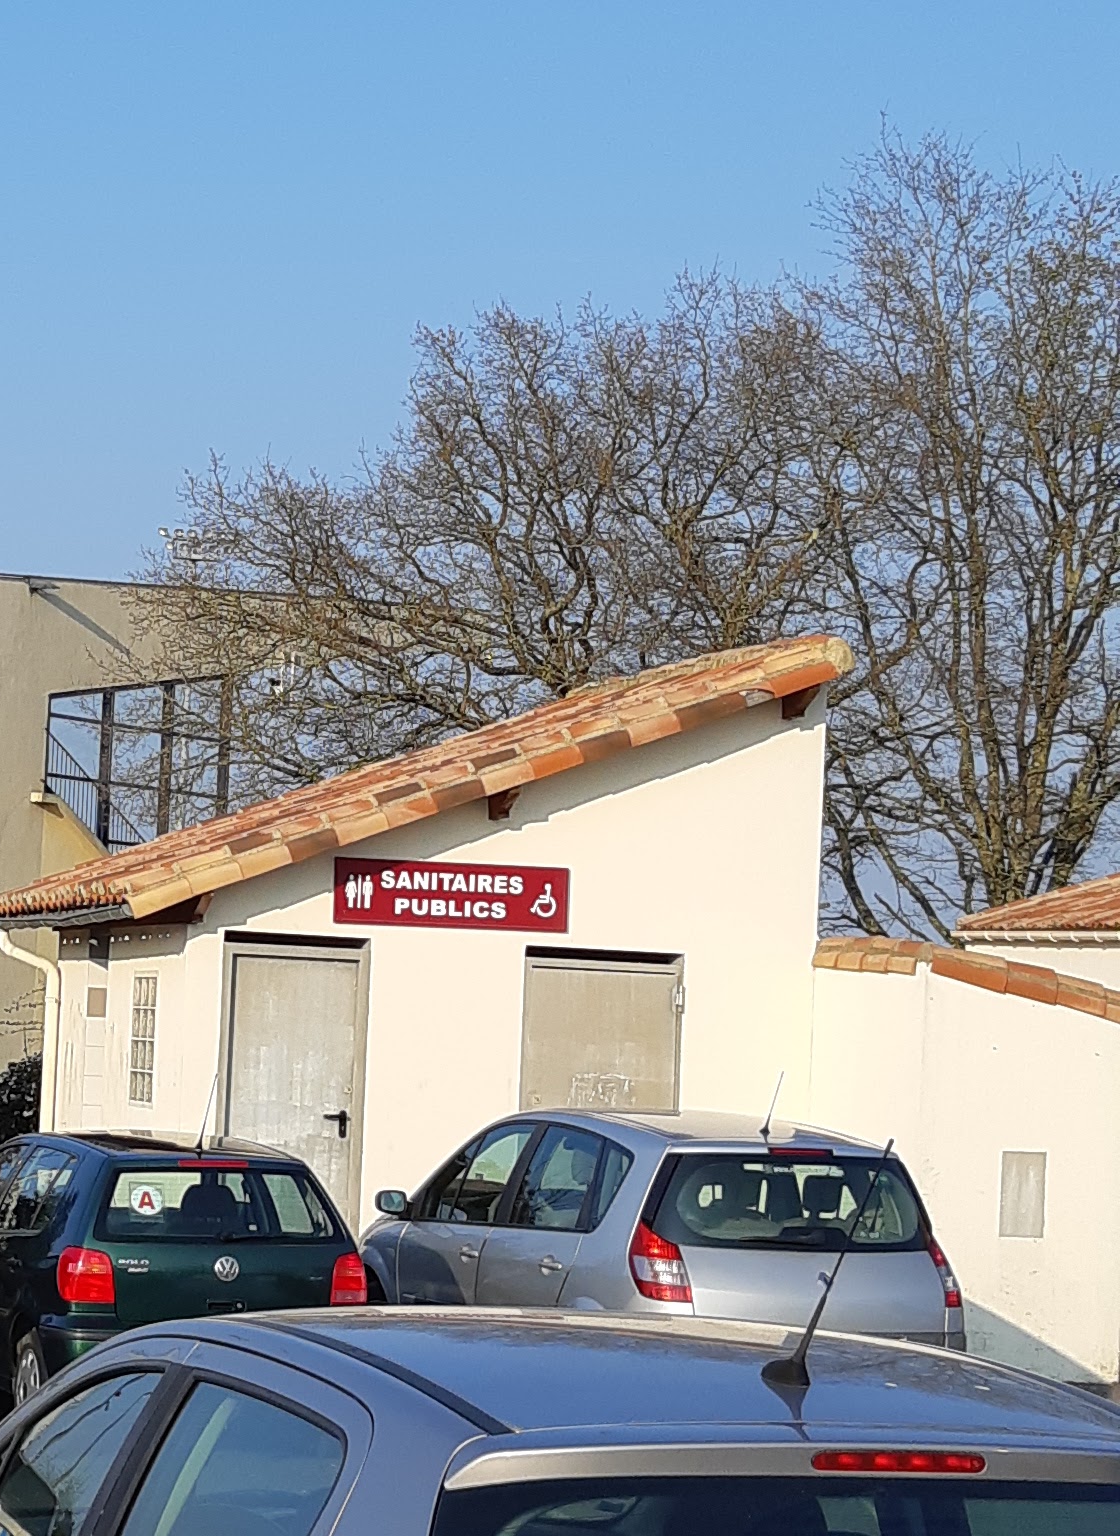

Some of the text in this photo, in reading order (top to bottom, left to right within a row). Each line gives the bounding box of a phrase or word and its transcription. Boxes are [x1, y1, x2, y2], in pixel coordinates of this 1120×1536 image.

[380, 870, 524, 895] SANITAIRES
[394, 897, 507, 919] PUBLICS
[138, 1190, 156, 1210] A
